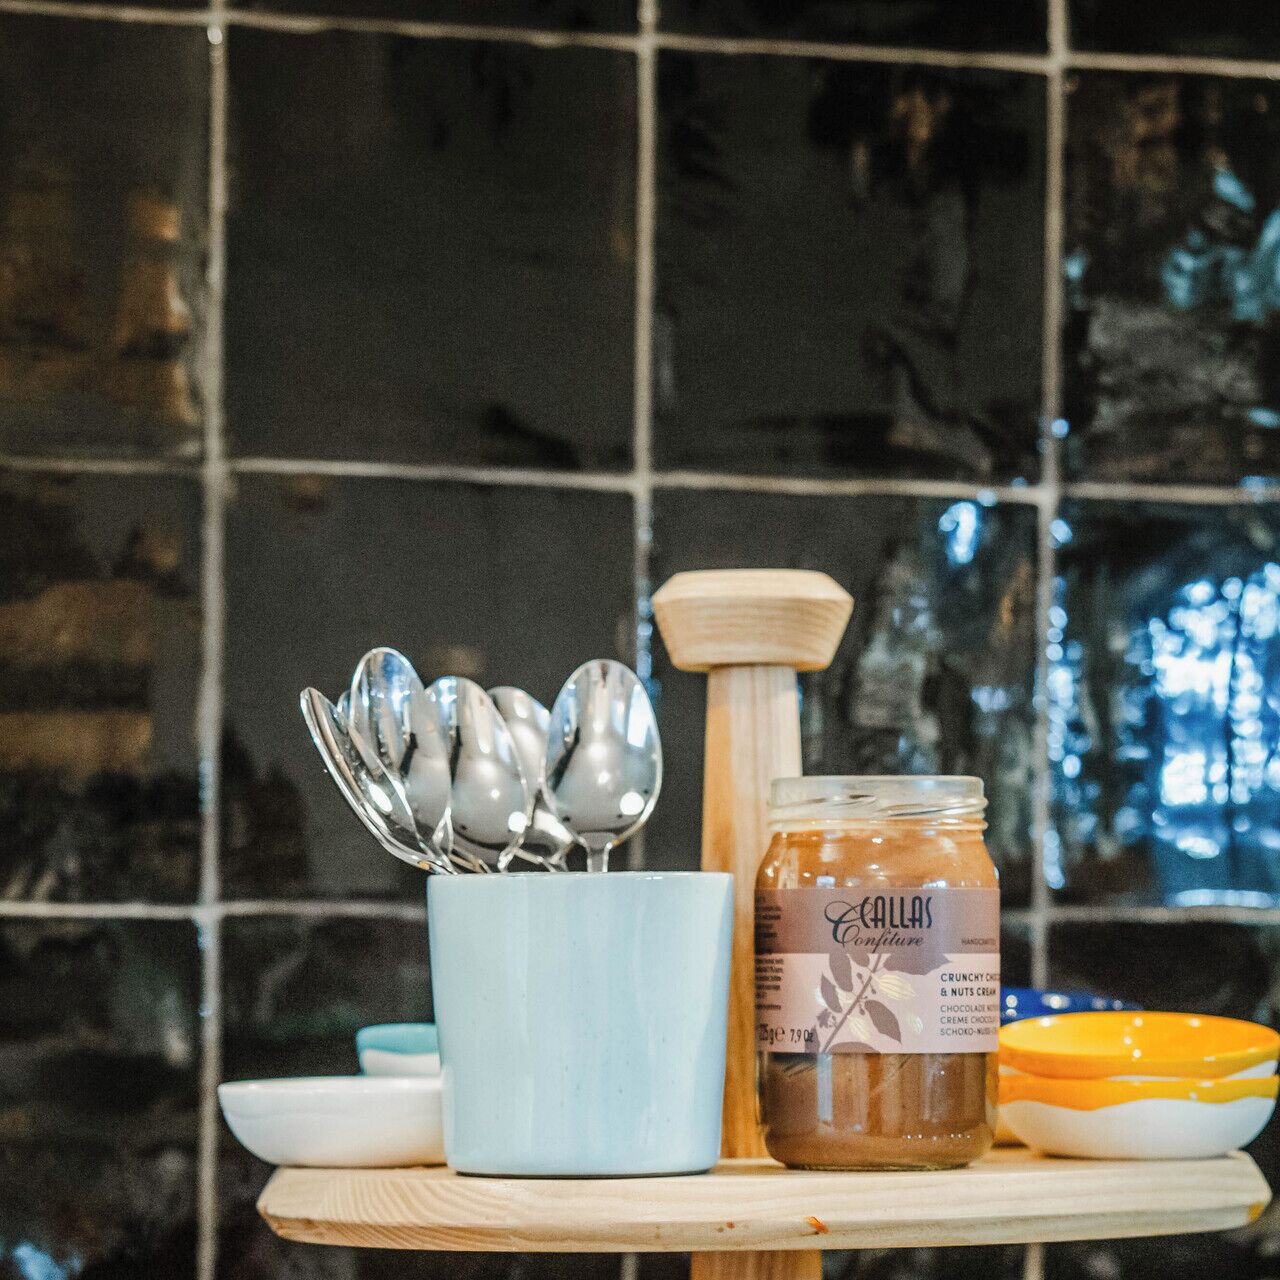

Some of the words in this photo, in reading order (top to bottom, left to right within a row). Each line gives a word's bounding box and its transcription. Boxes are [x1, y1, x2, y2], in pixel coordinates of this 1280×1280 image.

[859, 895, 933, 929] CALLAS
[940, 973, 984, 982] CRUNCHY
[940, 987, 947, 997] &
[951, 987, 974, 997] NUTS
